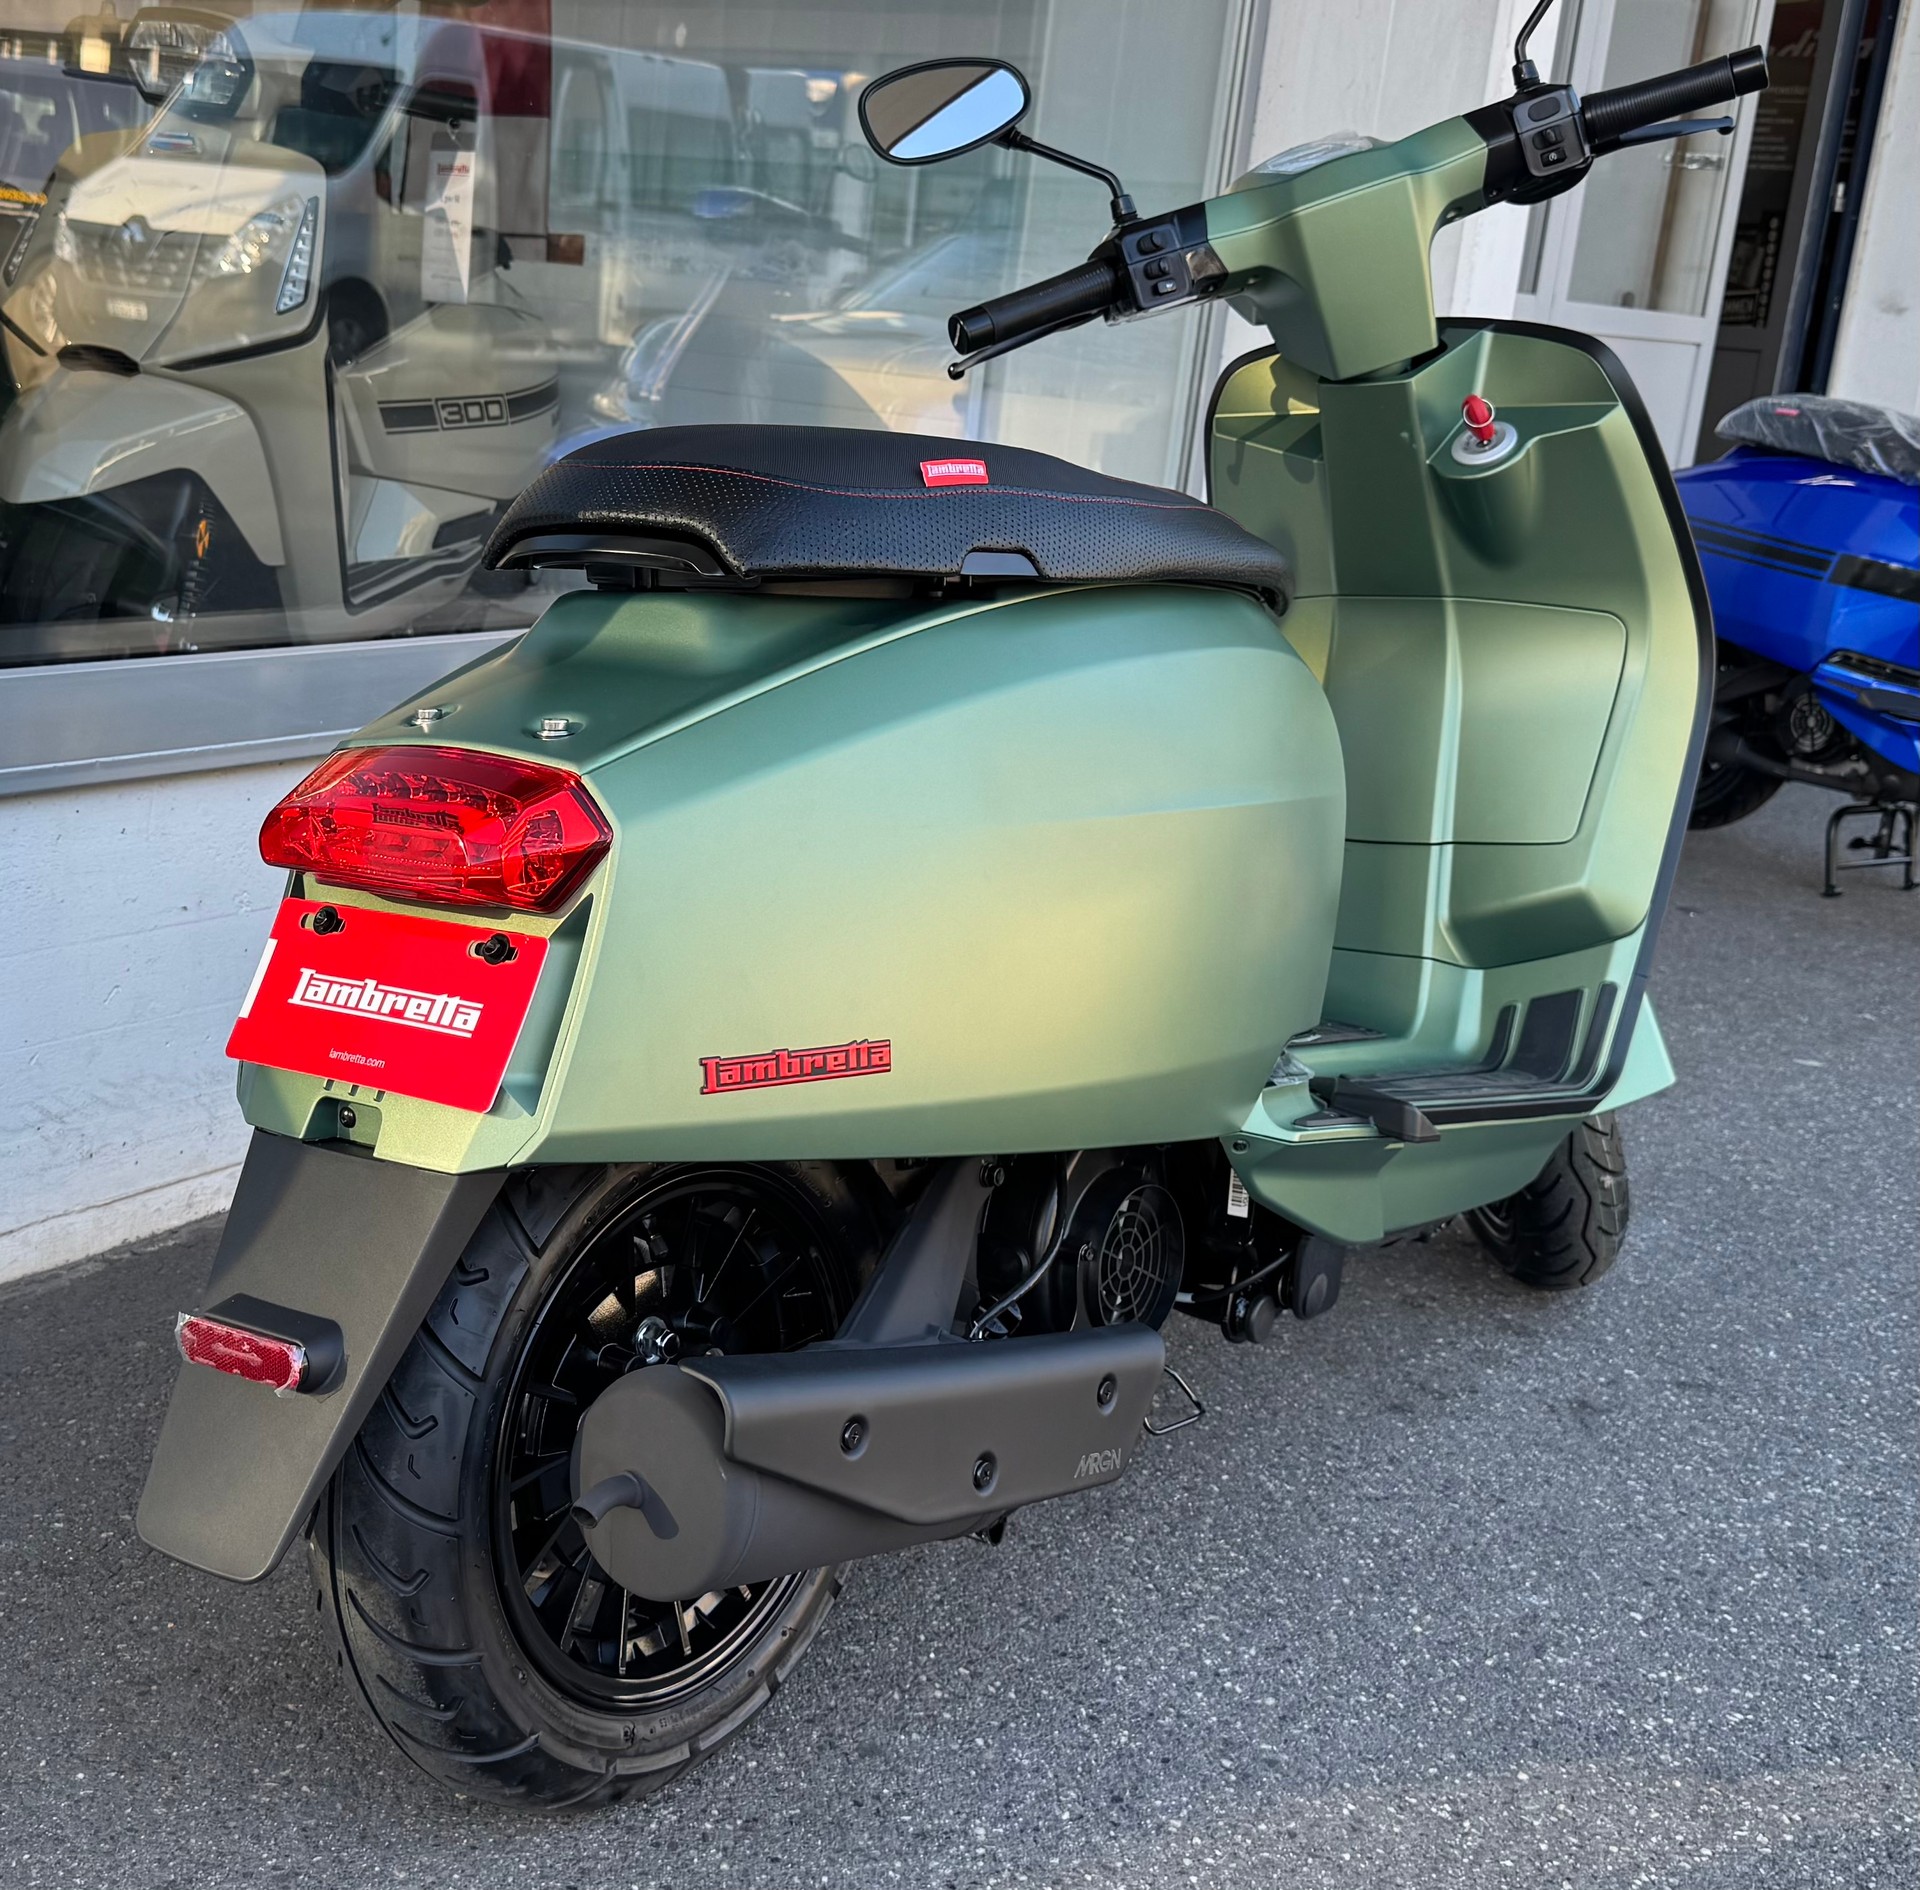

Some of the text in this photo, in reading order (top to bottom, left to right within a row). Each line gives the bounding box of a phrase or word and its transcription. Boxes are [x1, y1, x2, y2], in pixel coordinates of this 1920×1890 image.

[440, 400, 503, 425] 300
[926, 463, 984, 478] Lambretta
[287, 967, 485, 1039] Lambretta
[329, 1048, 385, 1069] lambretta.com
[700, 1039, 891, 1095] Lambretta
[1073, 1447, 1122, 1479] MRGN
